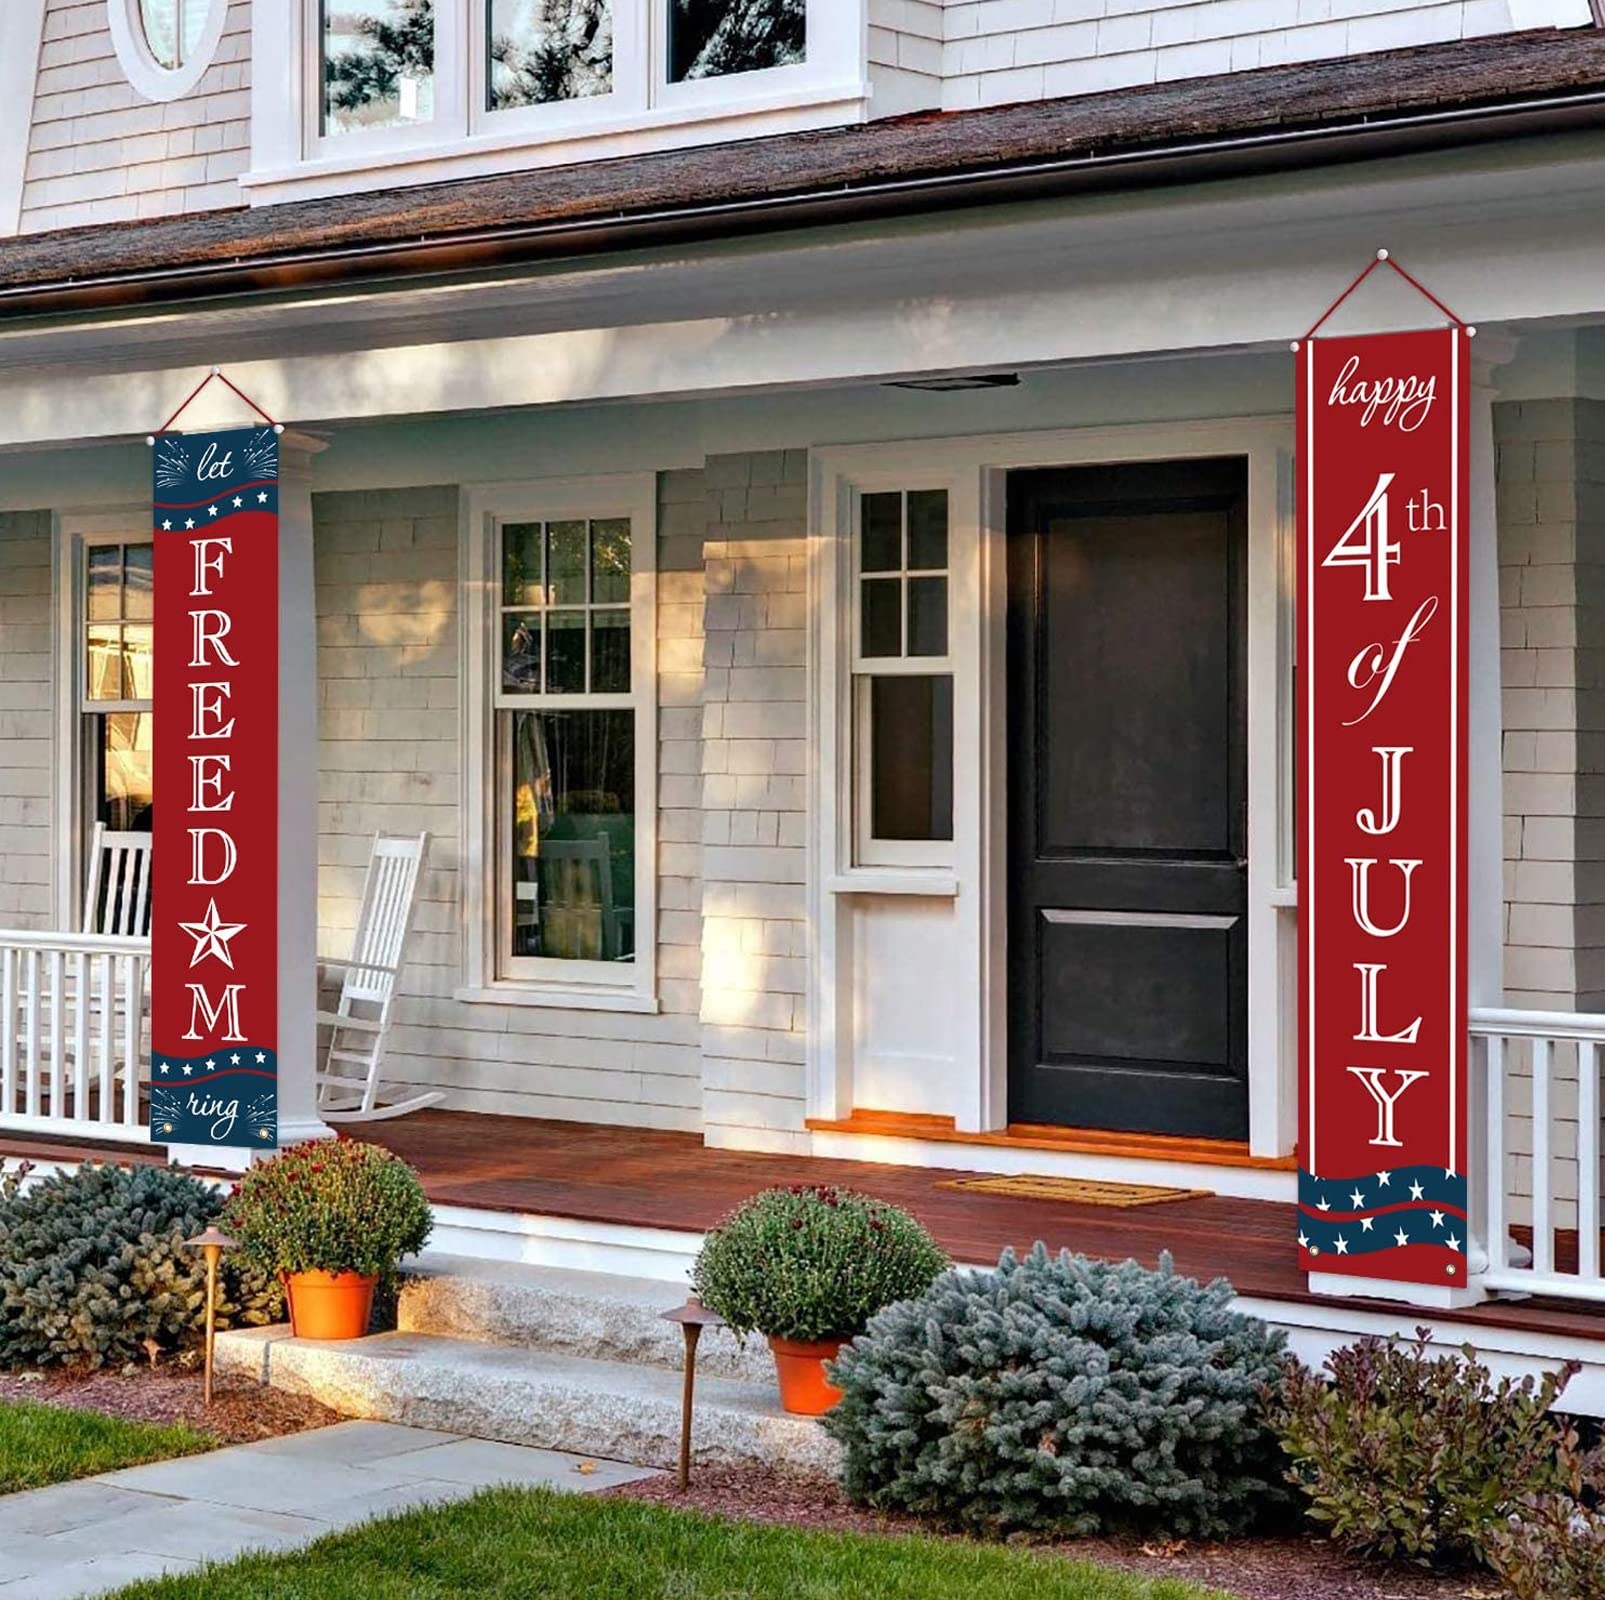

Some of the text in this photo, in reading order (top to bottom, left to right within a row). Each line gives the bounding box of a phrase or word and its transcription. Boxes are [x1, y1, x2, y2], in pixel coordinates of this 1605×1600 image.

[1328, 355, 1436, 431] happy
[197, 443, 234, 480] let
[1322, 473, 1446, 602] 4th
[1342, 596, 1438, 726] of
[178, 537, 248, 1042] FREEDM
[1344, 746, 1430, 1147] JULY
[186, 1092, 239, 1140] ring
